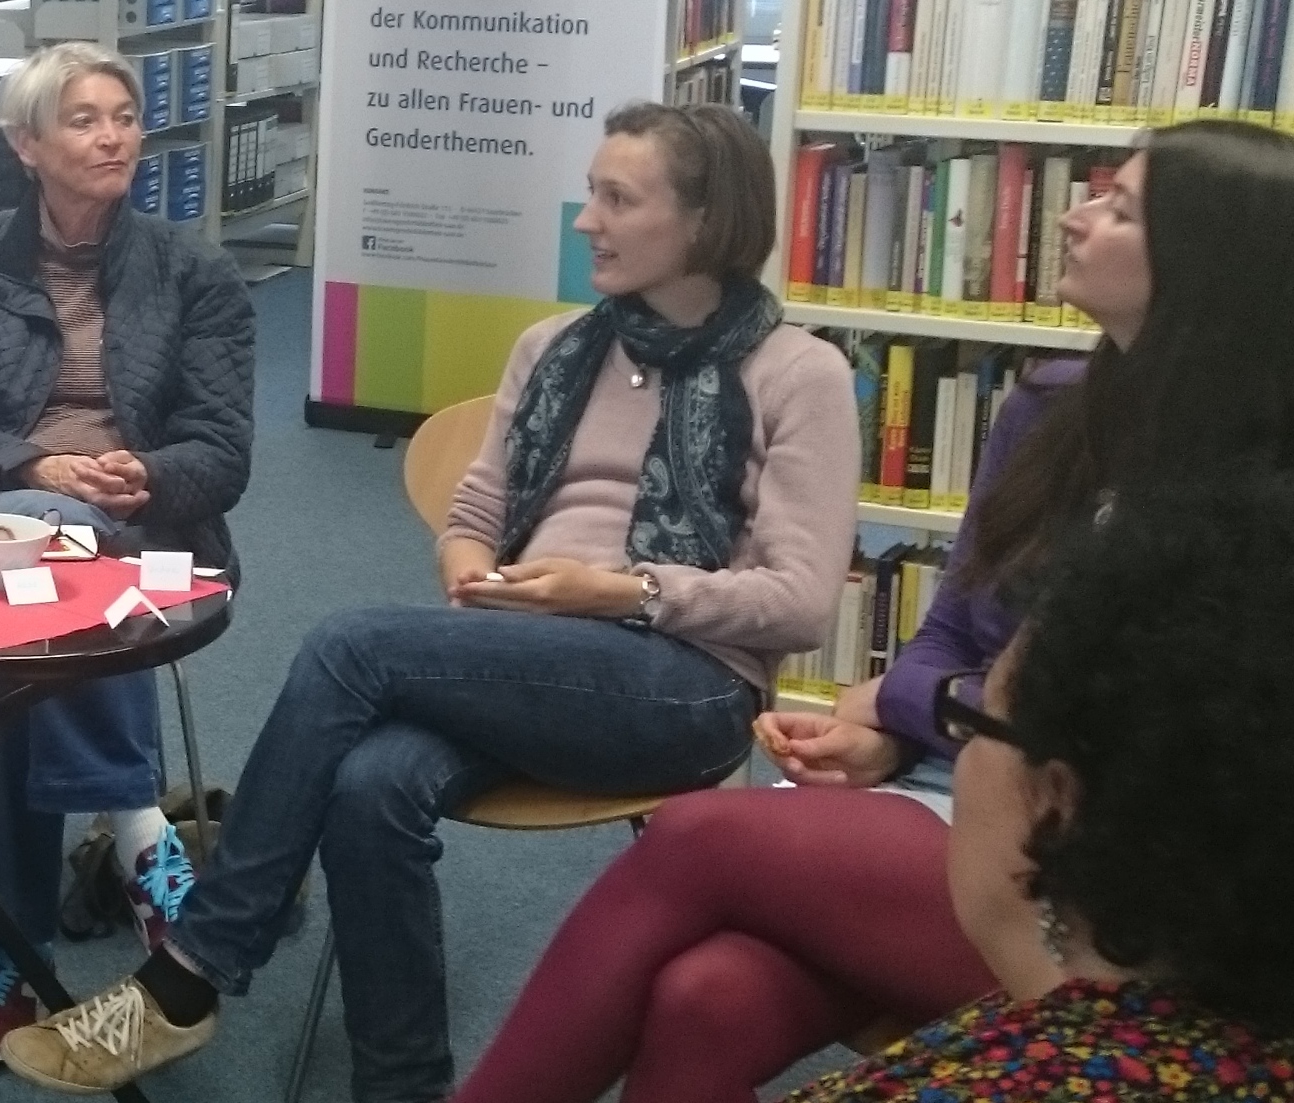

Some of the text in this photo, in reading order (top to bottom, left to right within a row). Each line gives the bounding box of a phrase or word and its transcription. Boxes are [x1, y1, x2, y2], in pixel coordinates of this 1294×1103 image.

[370, 7, 589, 36] der Kommunikation
[368, 48, 408, 69] und
[417, 50, 529, 74] Recherche
[366, 88, 595, 119] zu allen Frauen- und
[365, 127, 534, 157] Genderthemen.
